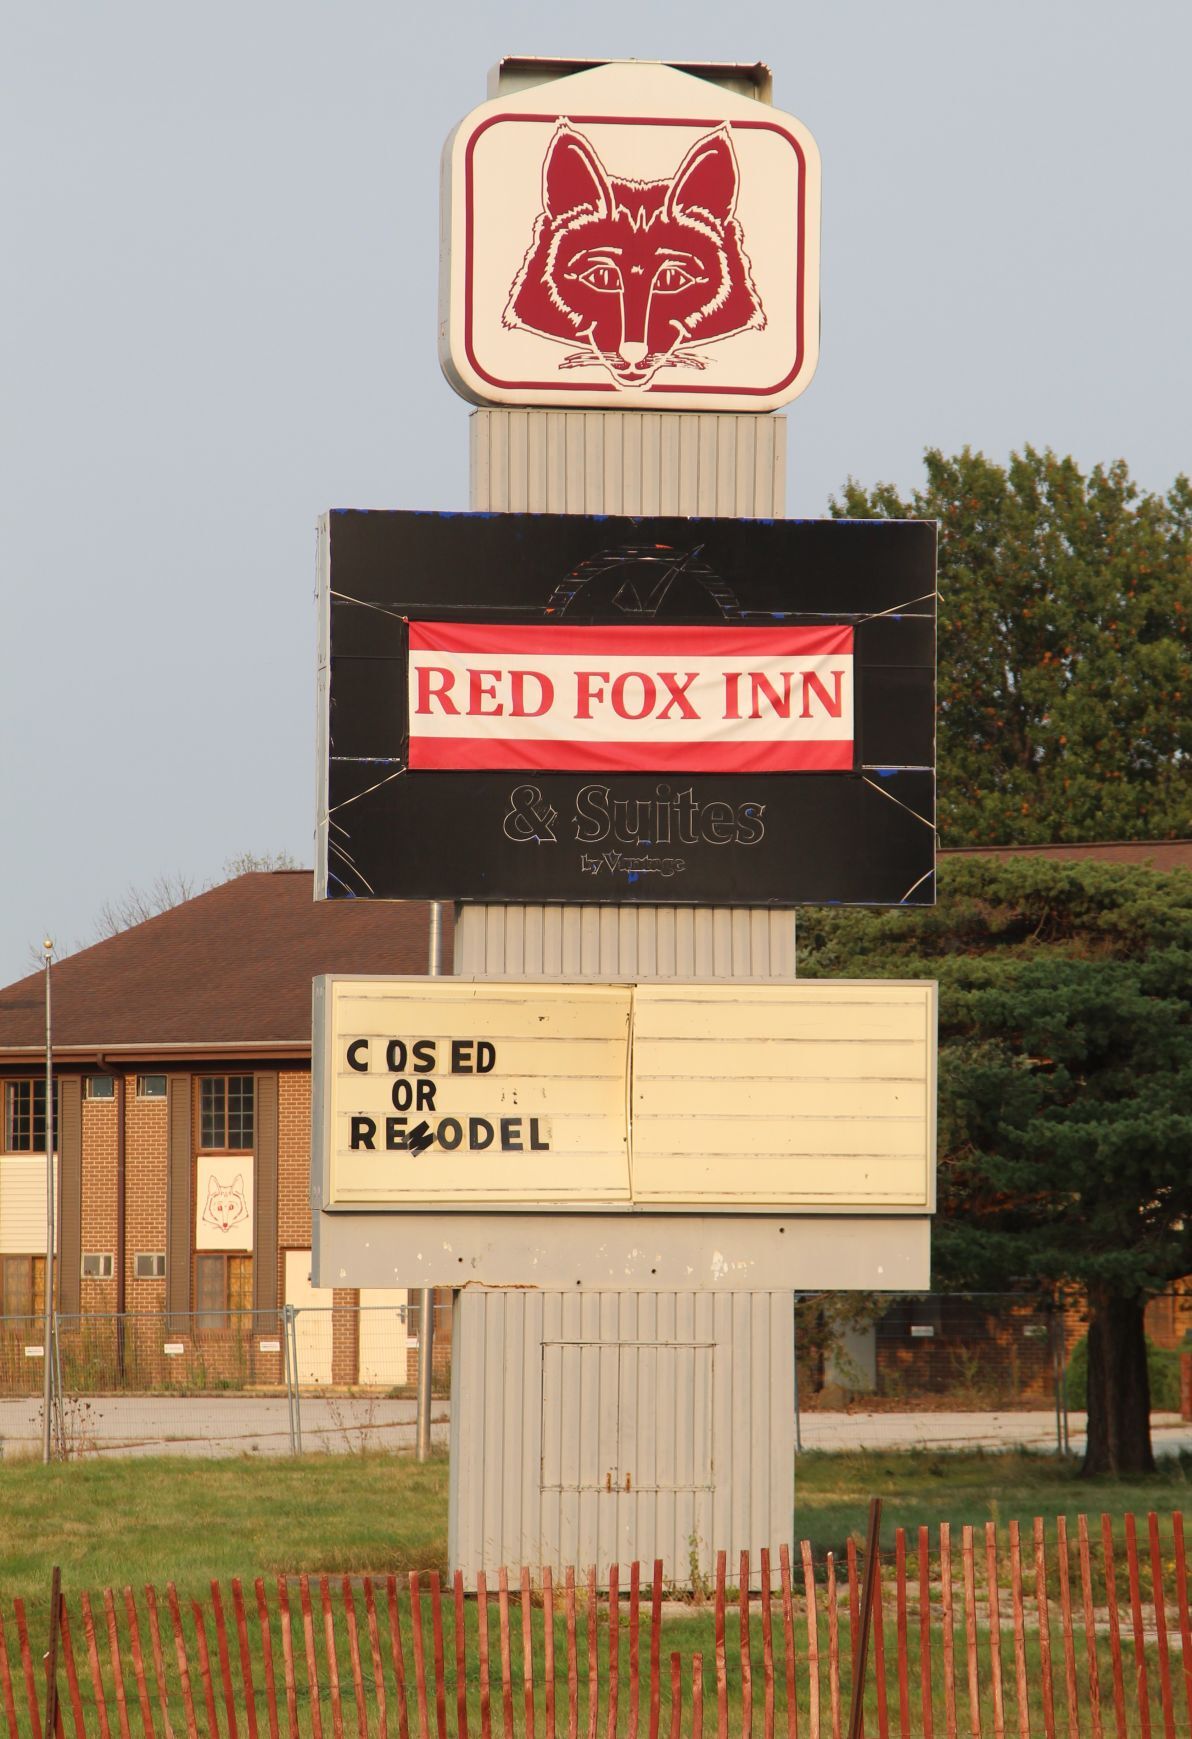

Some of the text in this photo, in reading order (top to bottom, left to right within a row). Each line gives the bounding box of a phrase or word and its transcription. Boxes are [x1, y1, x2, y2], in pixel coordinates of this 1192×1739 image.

[414, 666, 846, 720] RED FOX INN
[502, 783, 767, 846] & Suites
[391, 1078, 437, 1112] OR
